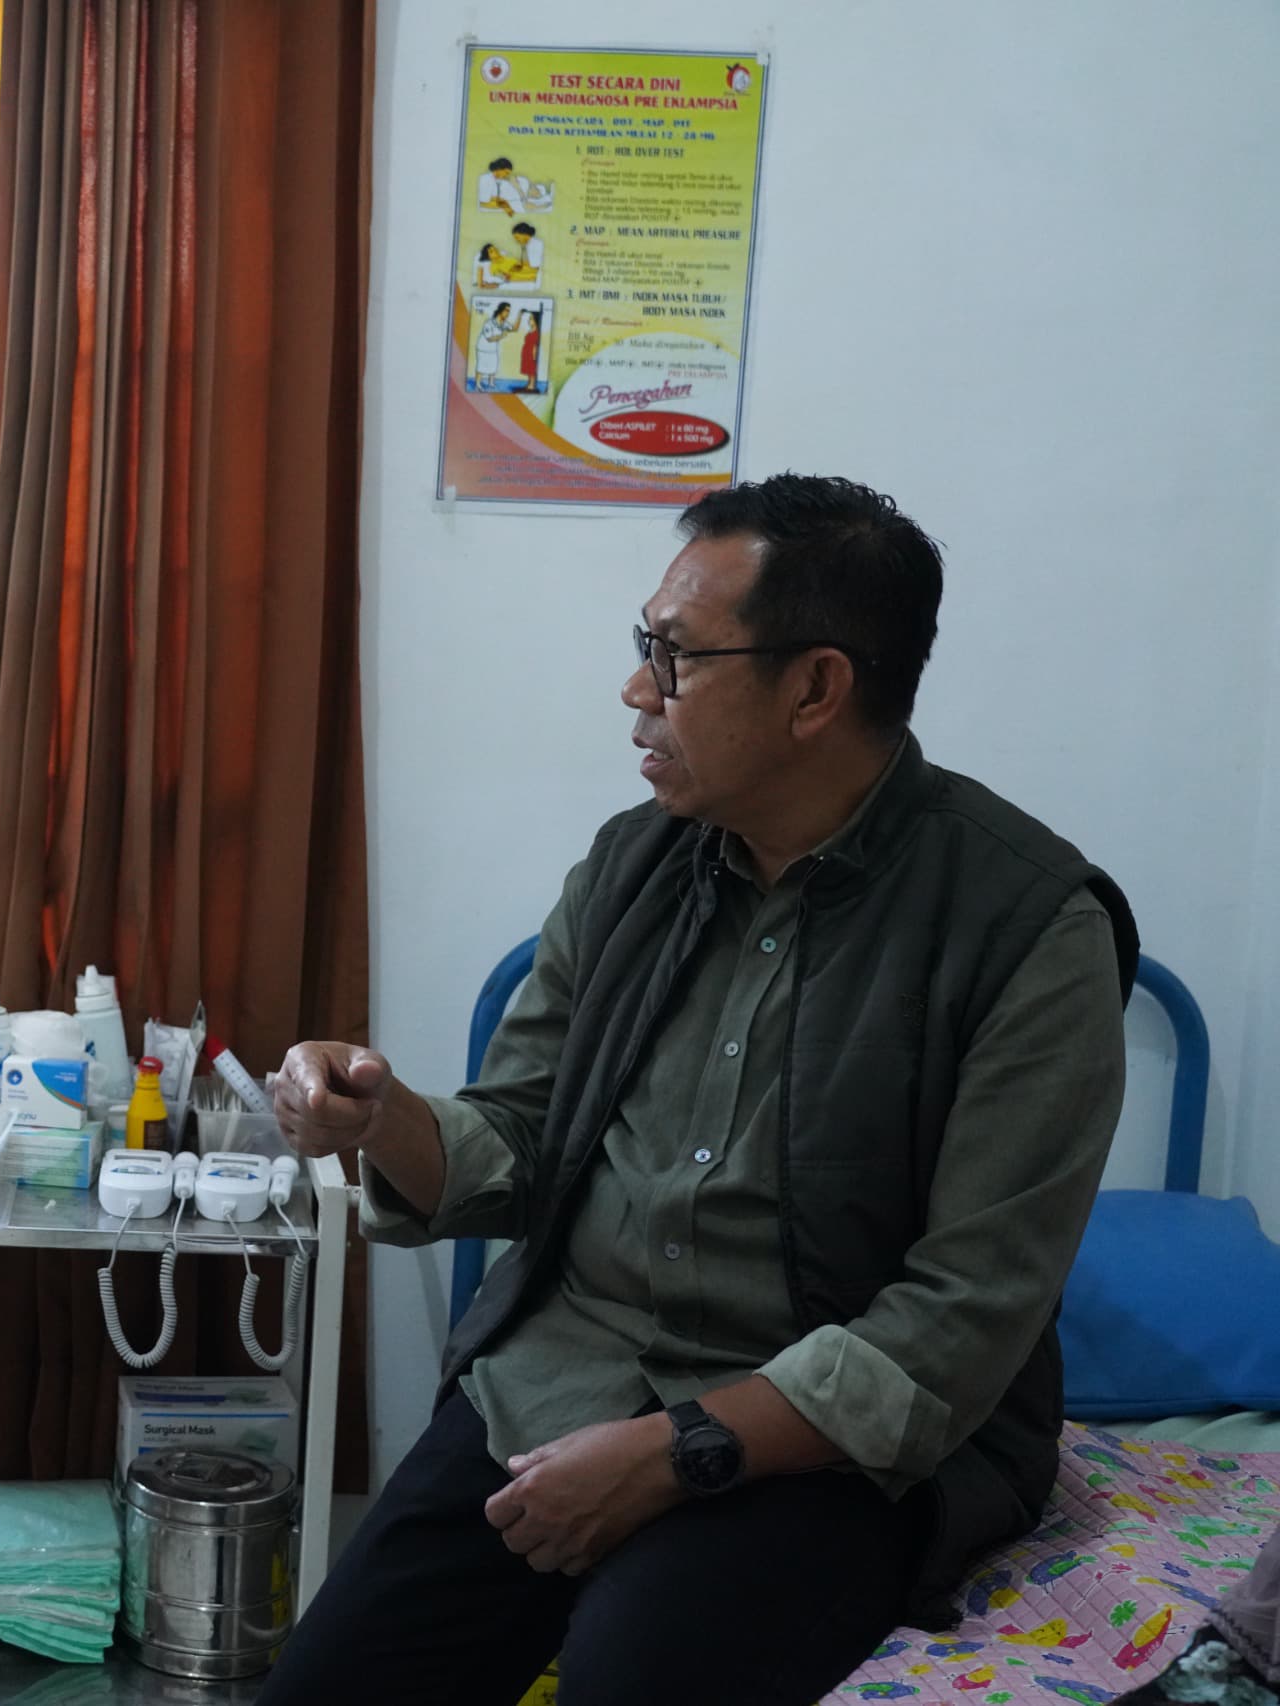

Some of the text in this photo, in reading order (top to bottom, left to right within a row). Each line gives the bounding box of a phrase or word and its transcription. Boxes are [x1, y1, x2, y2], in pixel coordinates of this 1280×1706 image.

[550, 74, 681, 91] TEST SECARA DINI
[489, 91, 738, 110] UNTUK MENDIAGNOSA PRE EKLAMPSIA
[635, 147, 661, 157] OVER
[663, 148, 685, 158] TEST
[584, 226, 606, 236] MAP
[617, 227, 644, 238] MEAN
[647, 228, 690, 239] ARTERIAL
[661, 292, 689, 303] MASA
[642, 305, 667, 316] BODY
[669, 307, 696, 318] MASA
[579, 380, 693, 414] Pencegahan
[144, 1424, 217, 1437] Surgical Mask
